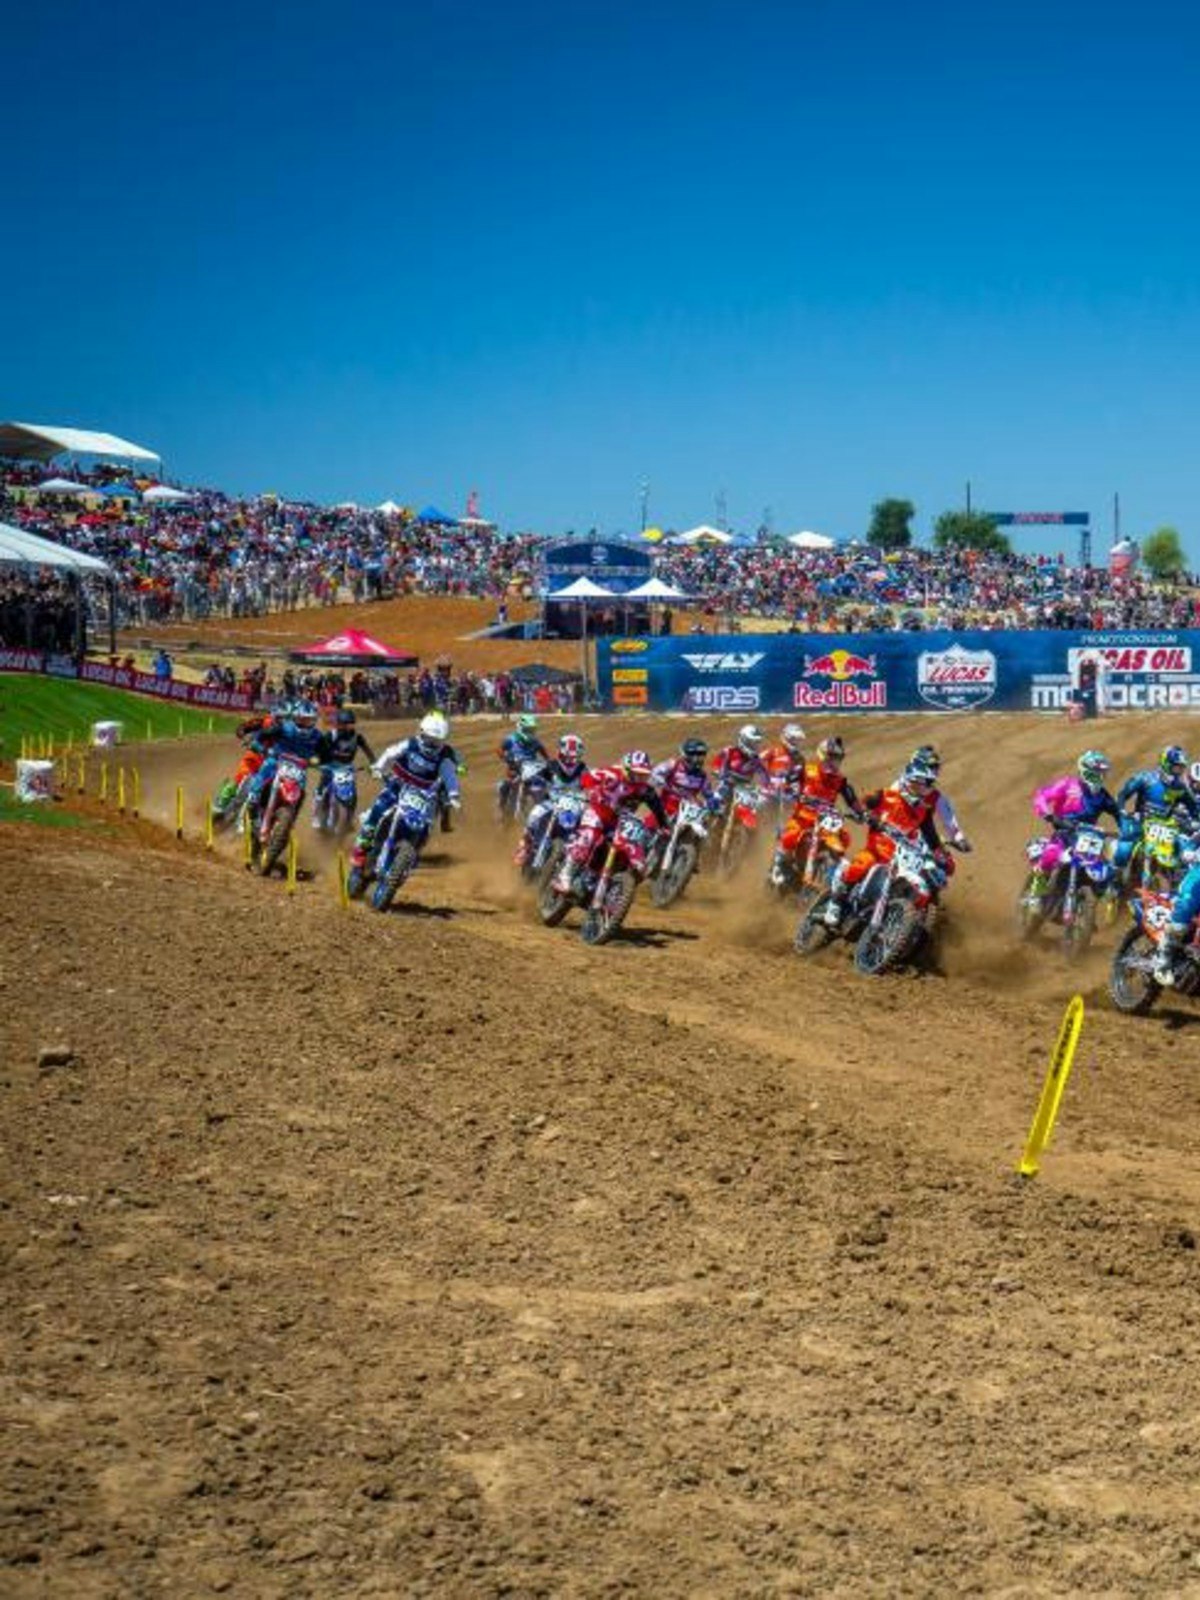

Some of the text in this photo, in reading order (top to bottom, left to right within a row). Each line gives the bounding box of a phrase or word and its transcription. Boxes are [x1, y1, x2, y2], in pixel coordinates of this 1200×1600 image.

[1151, 650, 1186, 670] OIL
[929, 666, 990, 682] LUCAS
[794, 681, 887, 707] Red Bull
